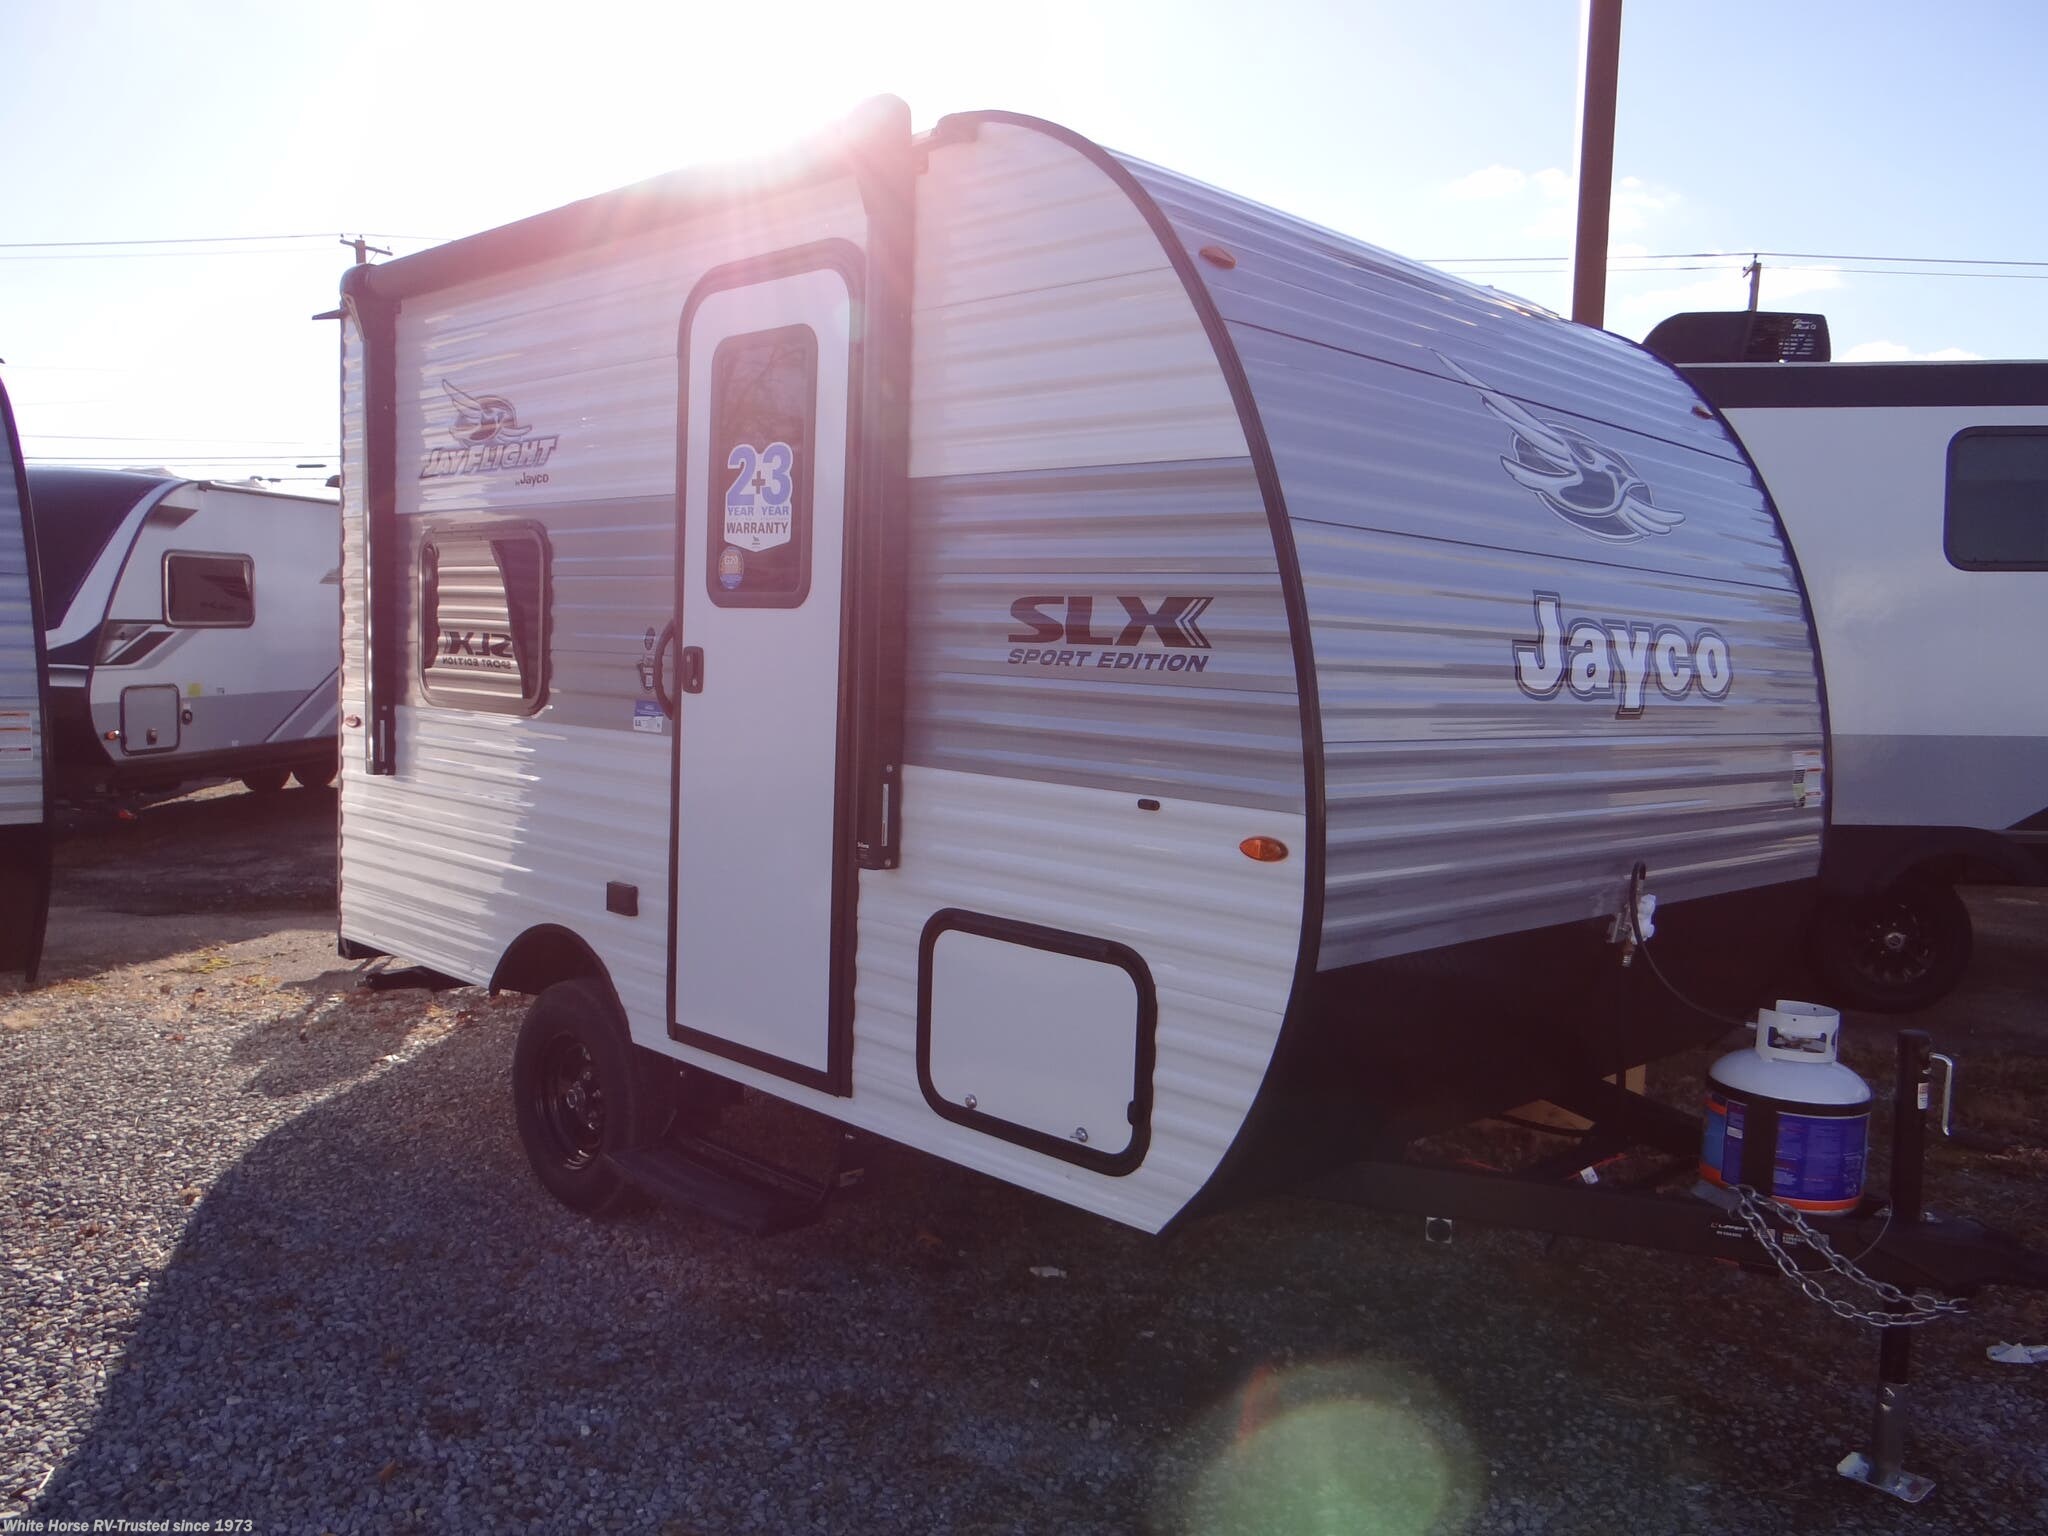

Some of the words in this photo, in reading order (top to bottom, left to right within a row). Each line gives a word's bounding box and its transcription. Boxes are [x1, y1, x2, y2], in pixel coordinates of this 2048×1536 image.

[519, 472, 550, 488] Jayco
[728, 507, 754, 516] YEAR
[762, 506, 789, 516] YEAR
[727, 522, 789, 534] WARRANTY
[1008, 596, 1214, 648] SLX
[1008, 649, 1092, 667] SPORT
[1097, 652, 1209, 672] EDITION
[1512, 589, 1733, 720] Jayco
